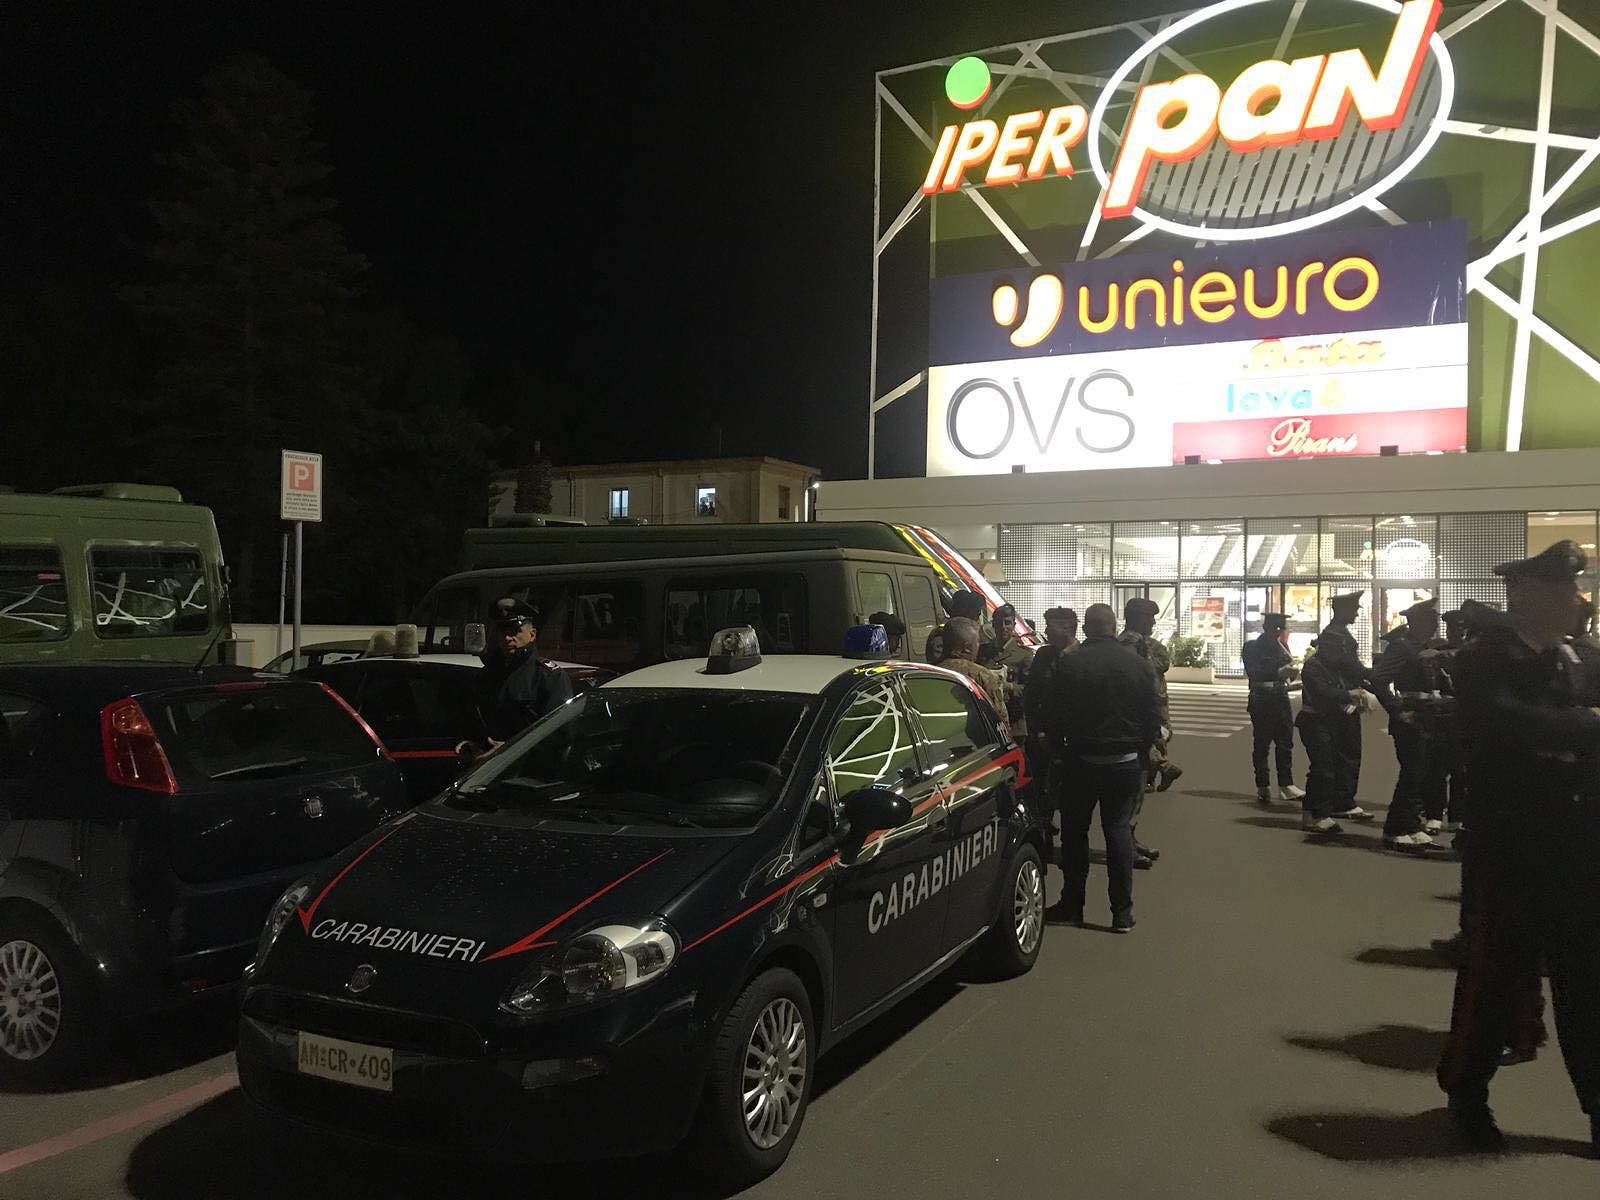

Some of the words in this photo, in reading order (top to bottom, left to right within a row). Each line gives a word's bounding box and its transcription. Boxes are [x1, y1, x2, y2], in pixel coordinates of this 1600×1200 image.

[1078, 257, 1380, 335] unieuro
[947, 369, 1135, 460] OVS
[294, 465, 310, 488] P
[868, 816, 1000, 934] CARABINIERI
[311, 918, 487, 963] CARABINIERI
